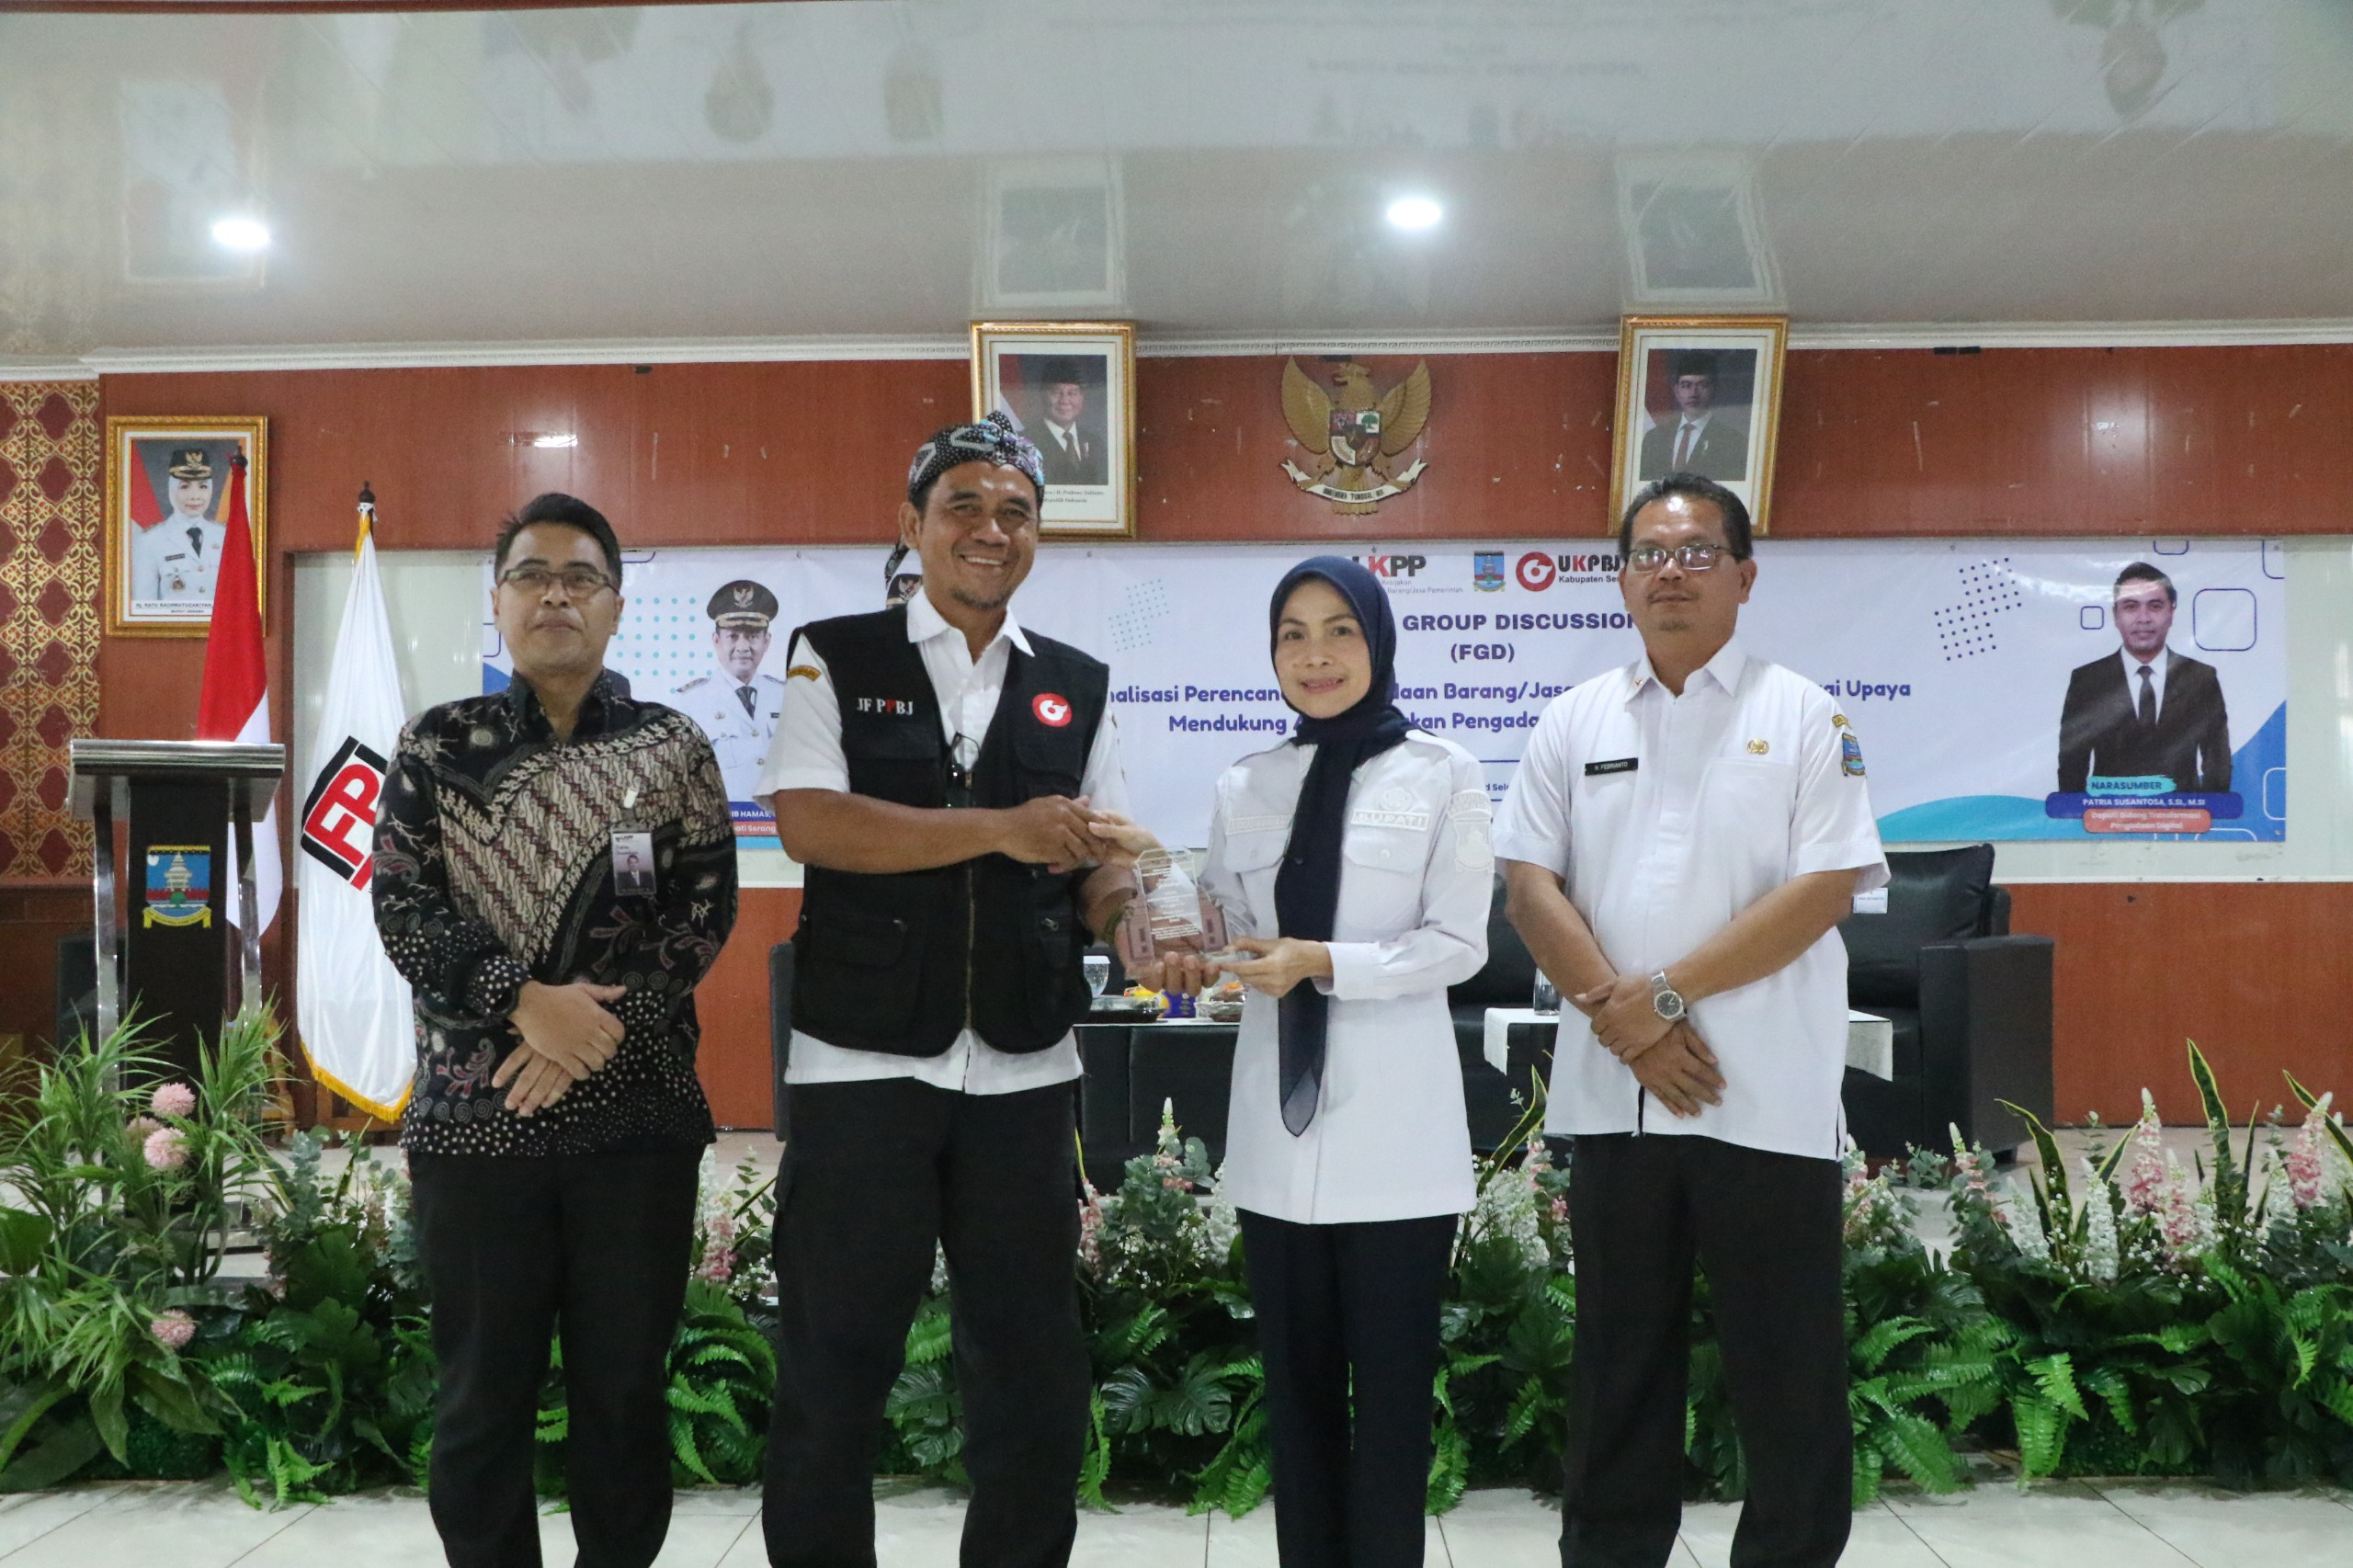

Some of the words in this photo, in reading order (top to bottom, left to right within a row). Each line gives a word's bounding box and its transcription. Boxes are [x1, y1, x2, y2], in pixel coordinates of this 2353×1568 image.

[1352, 555, 1427, 577] KPP
[1558, 554, 1620, 572] UKPBJ
[1558, 575, 1603, 584] Kabupaten
[1387, 586, 1426, 595] Barang/Jasa
[1402, 614, 1487, 631] GROUP
[1450, 643, 1515, 663] (FGD)
[1184, 686, 1285, 703] Perencan
[1847, 680, 1911, 701] Upaya
[857, 698, 871, 711] JF
[876, 699, 914, 715] PPBJ
[1168, 714, 1288, 735] Mendukung
[1405, 712, 1446, 729] kan
[1452, 711, 1540, 733] Pengada
[2091, 781, 2163, 790] NARASUMBER
[748, 824, 776, 833] Serang
[1358, 812, 1424, 828] BUPATI
